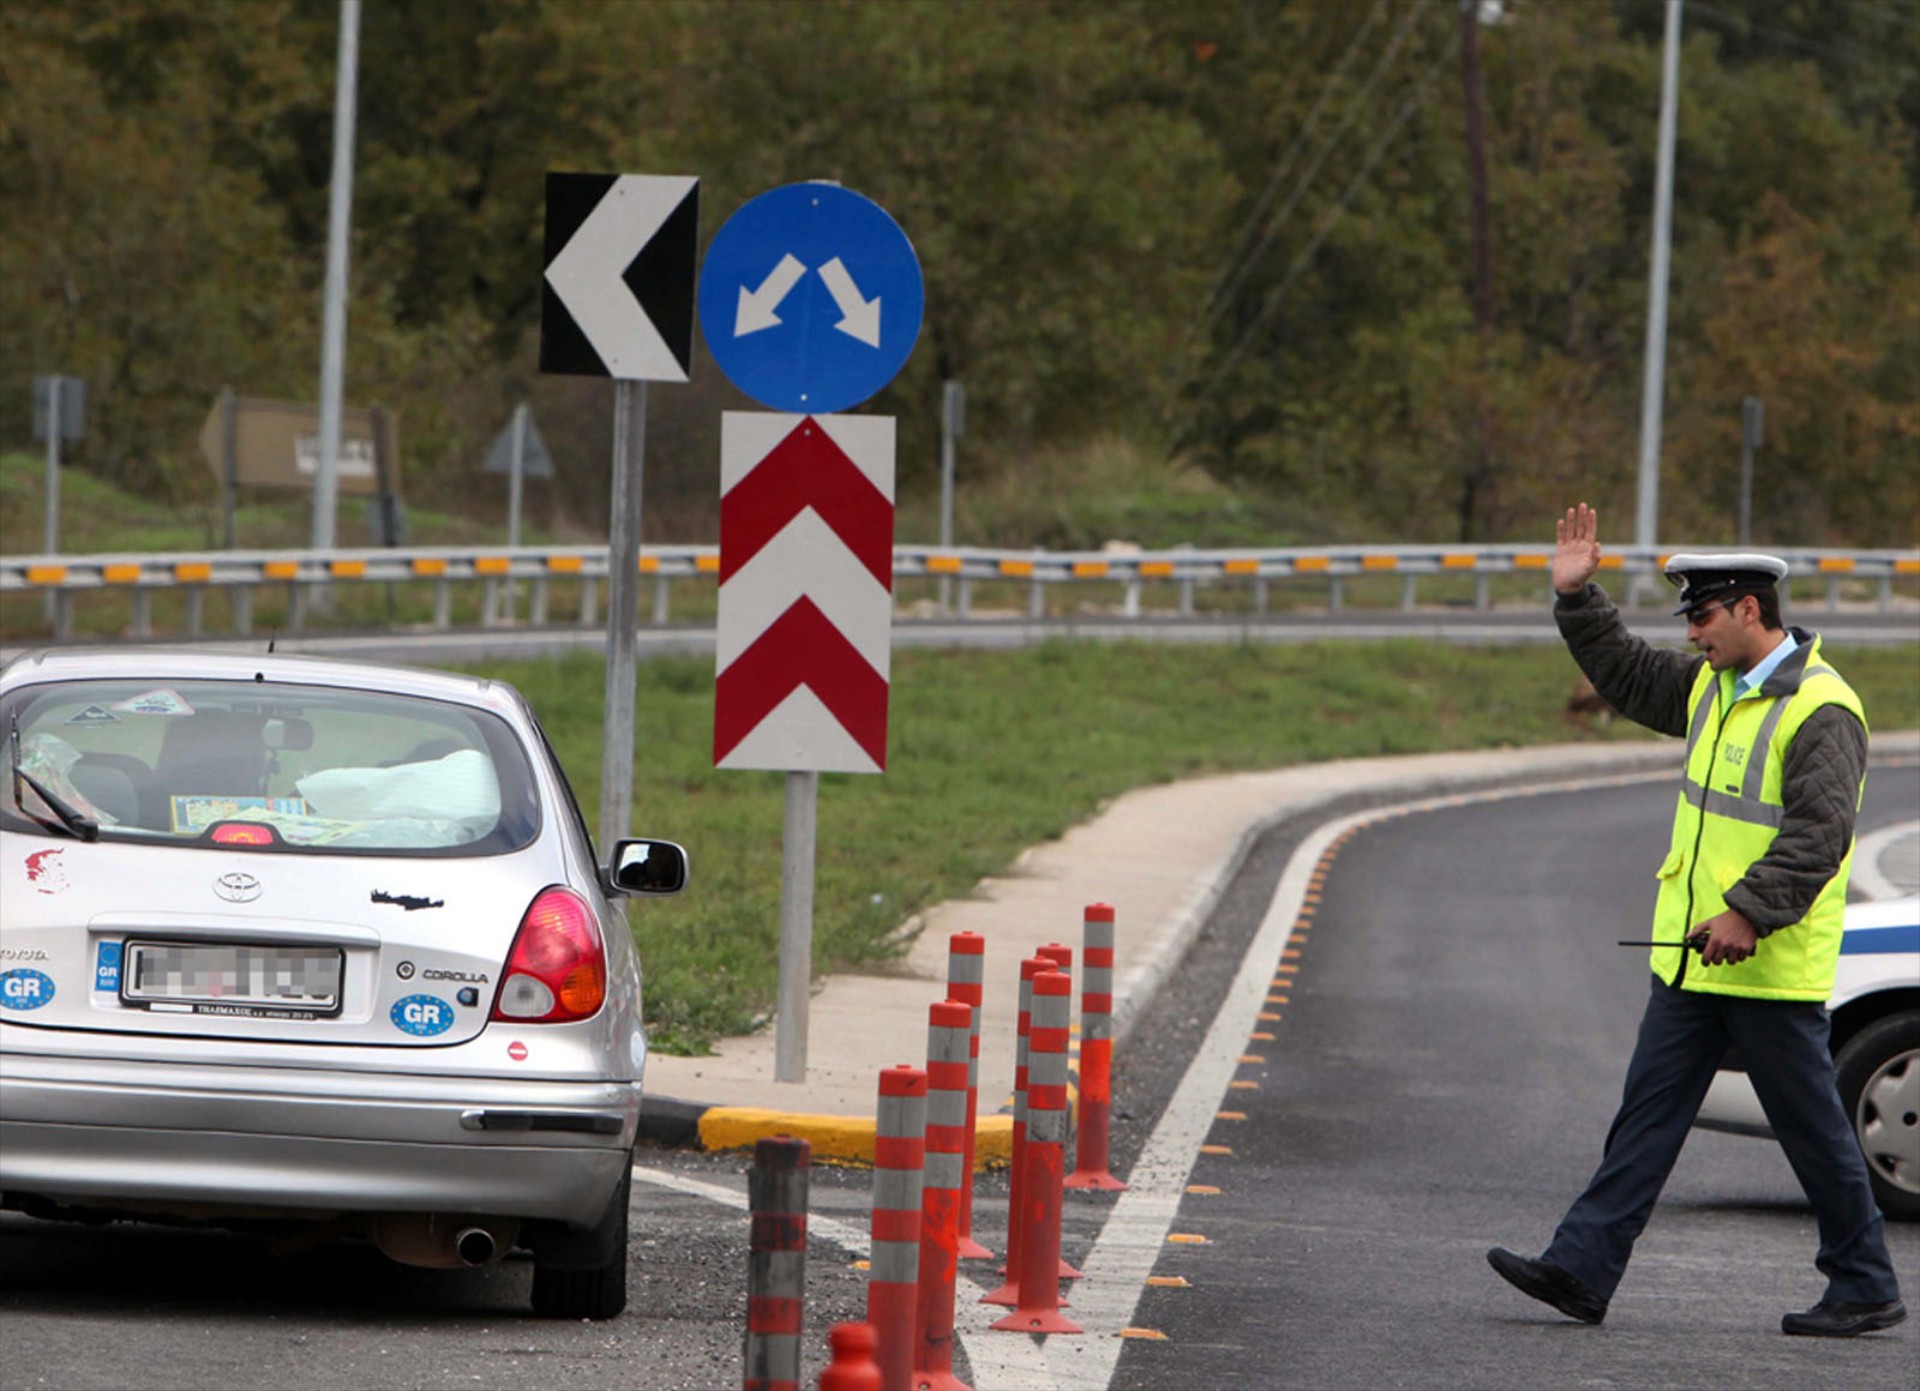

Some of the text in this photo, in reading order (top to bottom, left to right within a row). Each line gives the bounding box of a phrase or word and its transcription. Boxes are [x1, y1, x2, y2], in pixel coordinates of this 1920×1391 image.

[1725, 743, 1745, 766] POLICE
[98, 966, 118, 978] GR
[422, 969, 489, 984] COROLLA
[4, 977, 41, 998] GR
[403, 1003, 440, 1025] GR
